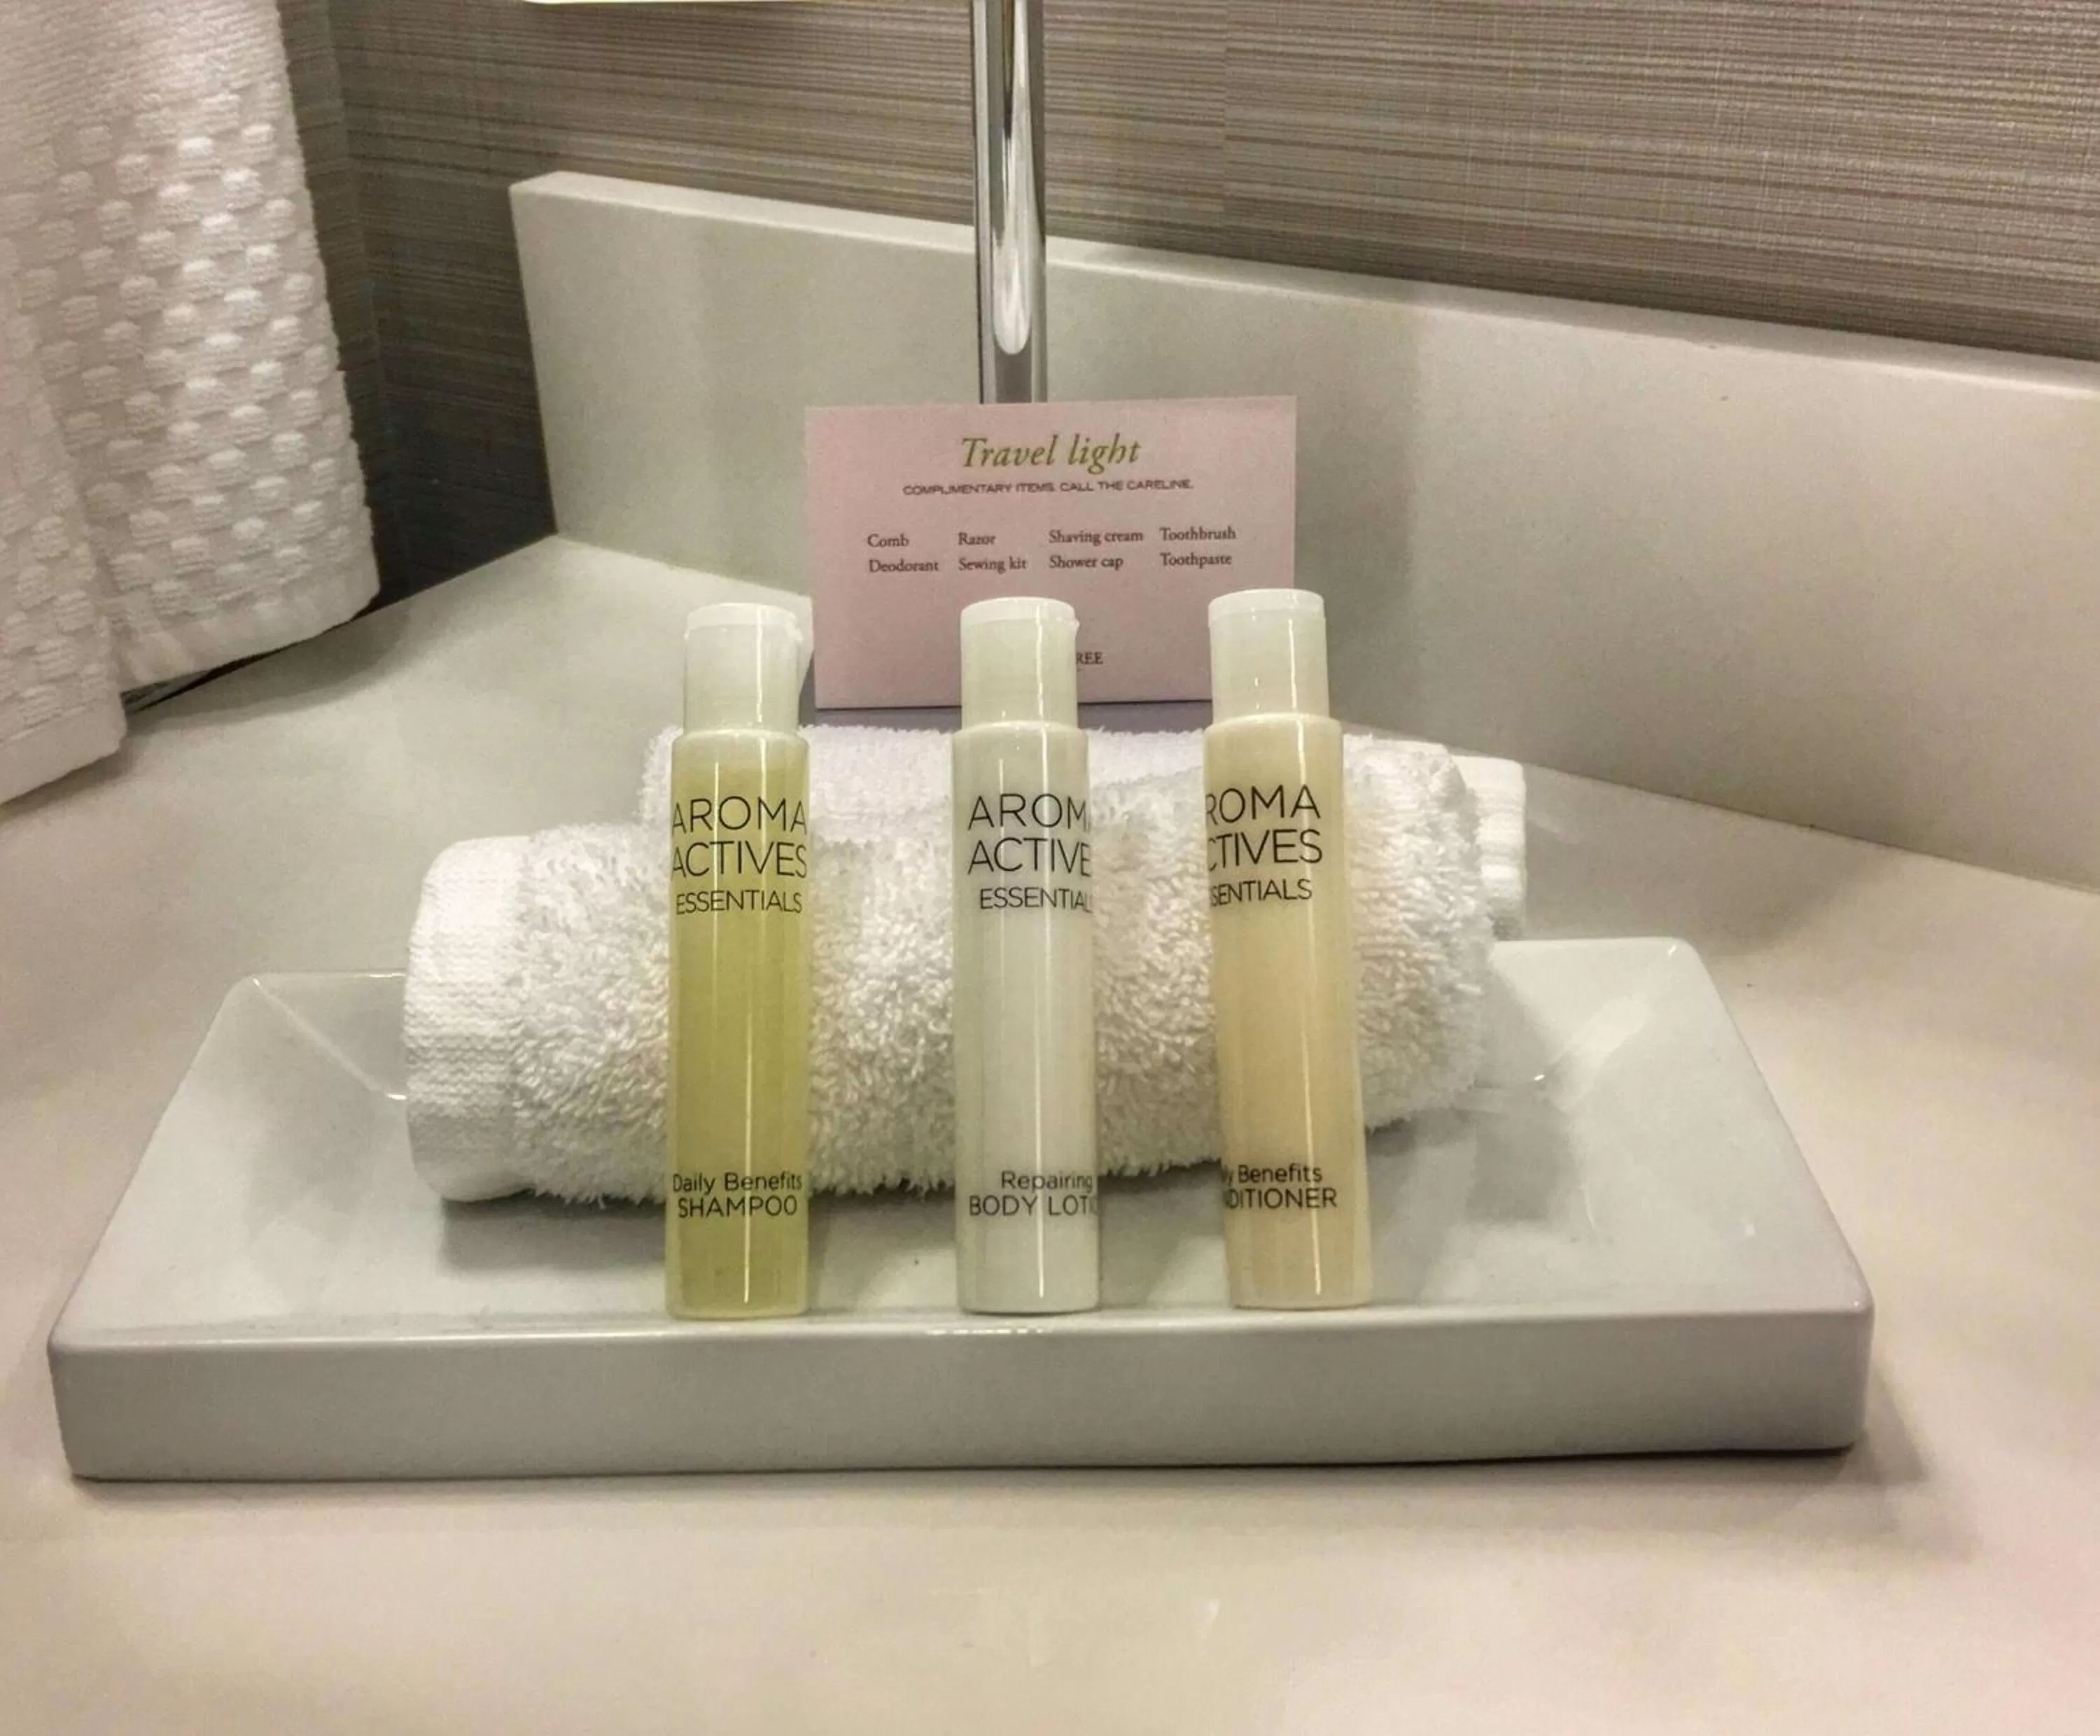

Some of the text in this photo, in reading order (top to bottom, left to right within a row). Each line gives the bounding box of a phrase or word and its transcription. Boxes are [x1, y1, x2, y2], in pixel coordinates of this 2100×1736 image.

[962, 432, 1142, 475] Travel light
[902, 483, 1012, 496] COMPLIMENTARY
[1060, 481, 1095, 492] CALL
[1097, 480, 1121, 491] THE
[867, 532, 910, 547] Comb
[958, 531, 997, 546] Razor
[1049, 528, 1144, 546] Shaving cream
[1159, 526, 1237, 542] Toothbrush
[869, 558, 939, 573] Deodorant
[958, 555, 1028, 575] Sewing kit
[1049, 554, 1124, 572] Shower cap
[1159, 551, 1233, 569] Toothpaste
[671, 795, 808, 835] AROMA
[671, 841, 808, 880] ACTIVES
[967, 836, 1092, 878] ACTIVE
[676, 890, 803, 916] ESSENTIALS
[672, 1170, 802, 1196] Daily Benefits
[1001, 1170, 1093, 1194] Repairing
[1237, 1163, 1323, 1184] Benefits
[678, 1194, 798, 1219] SHAMPOO
[969, 1194, 1039, 1217] BODY
